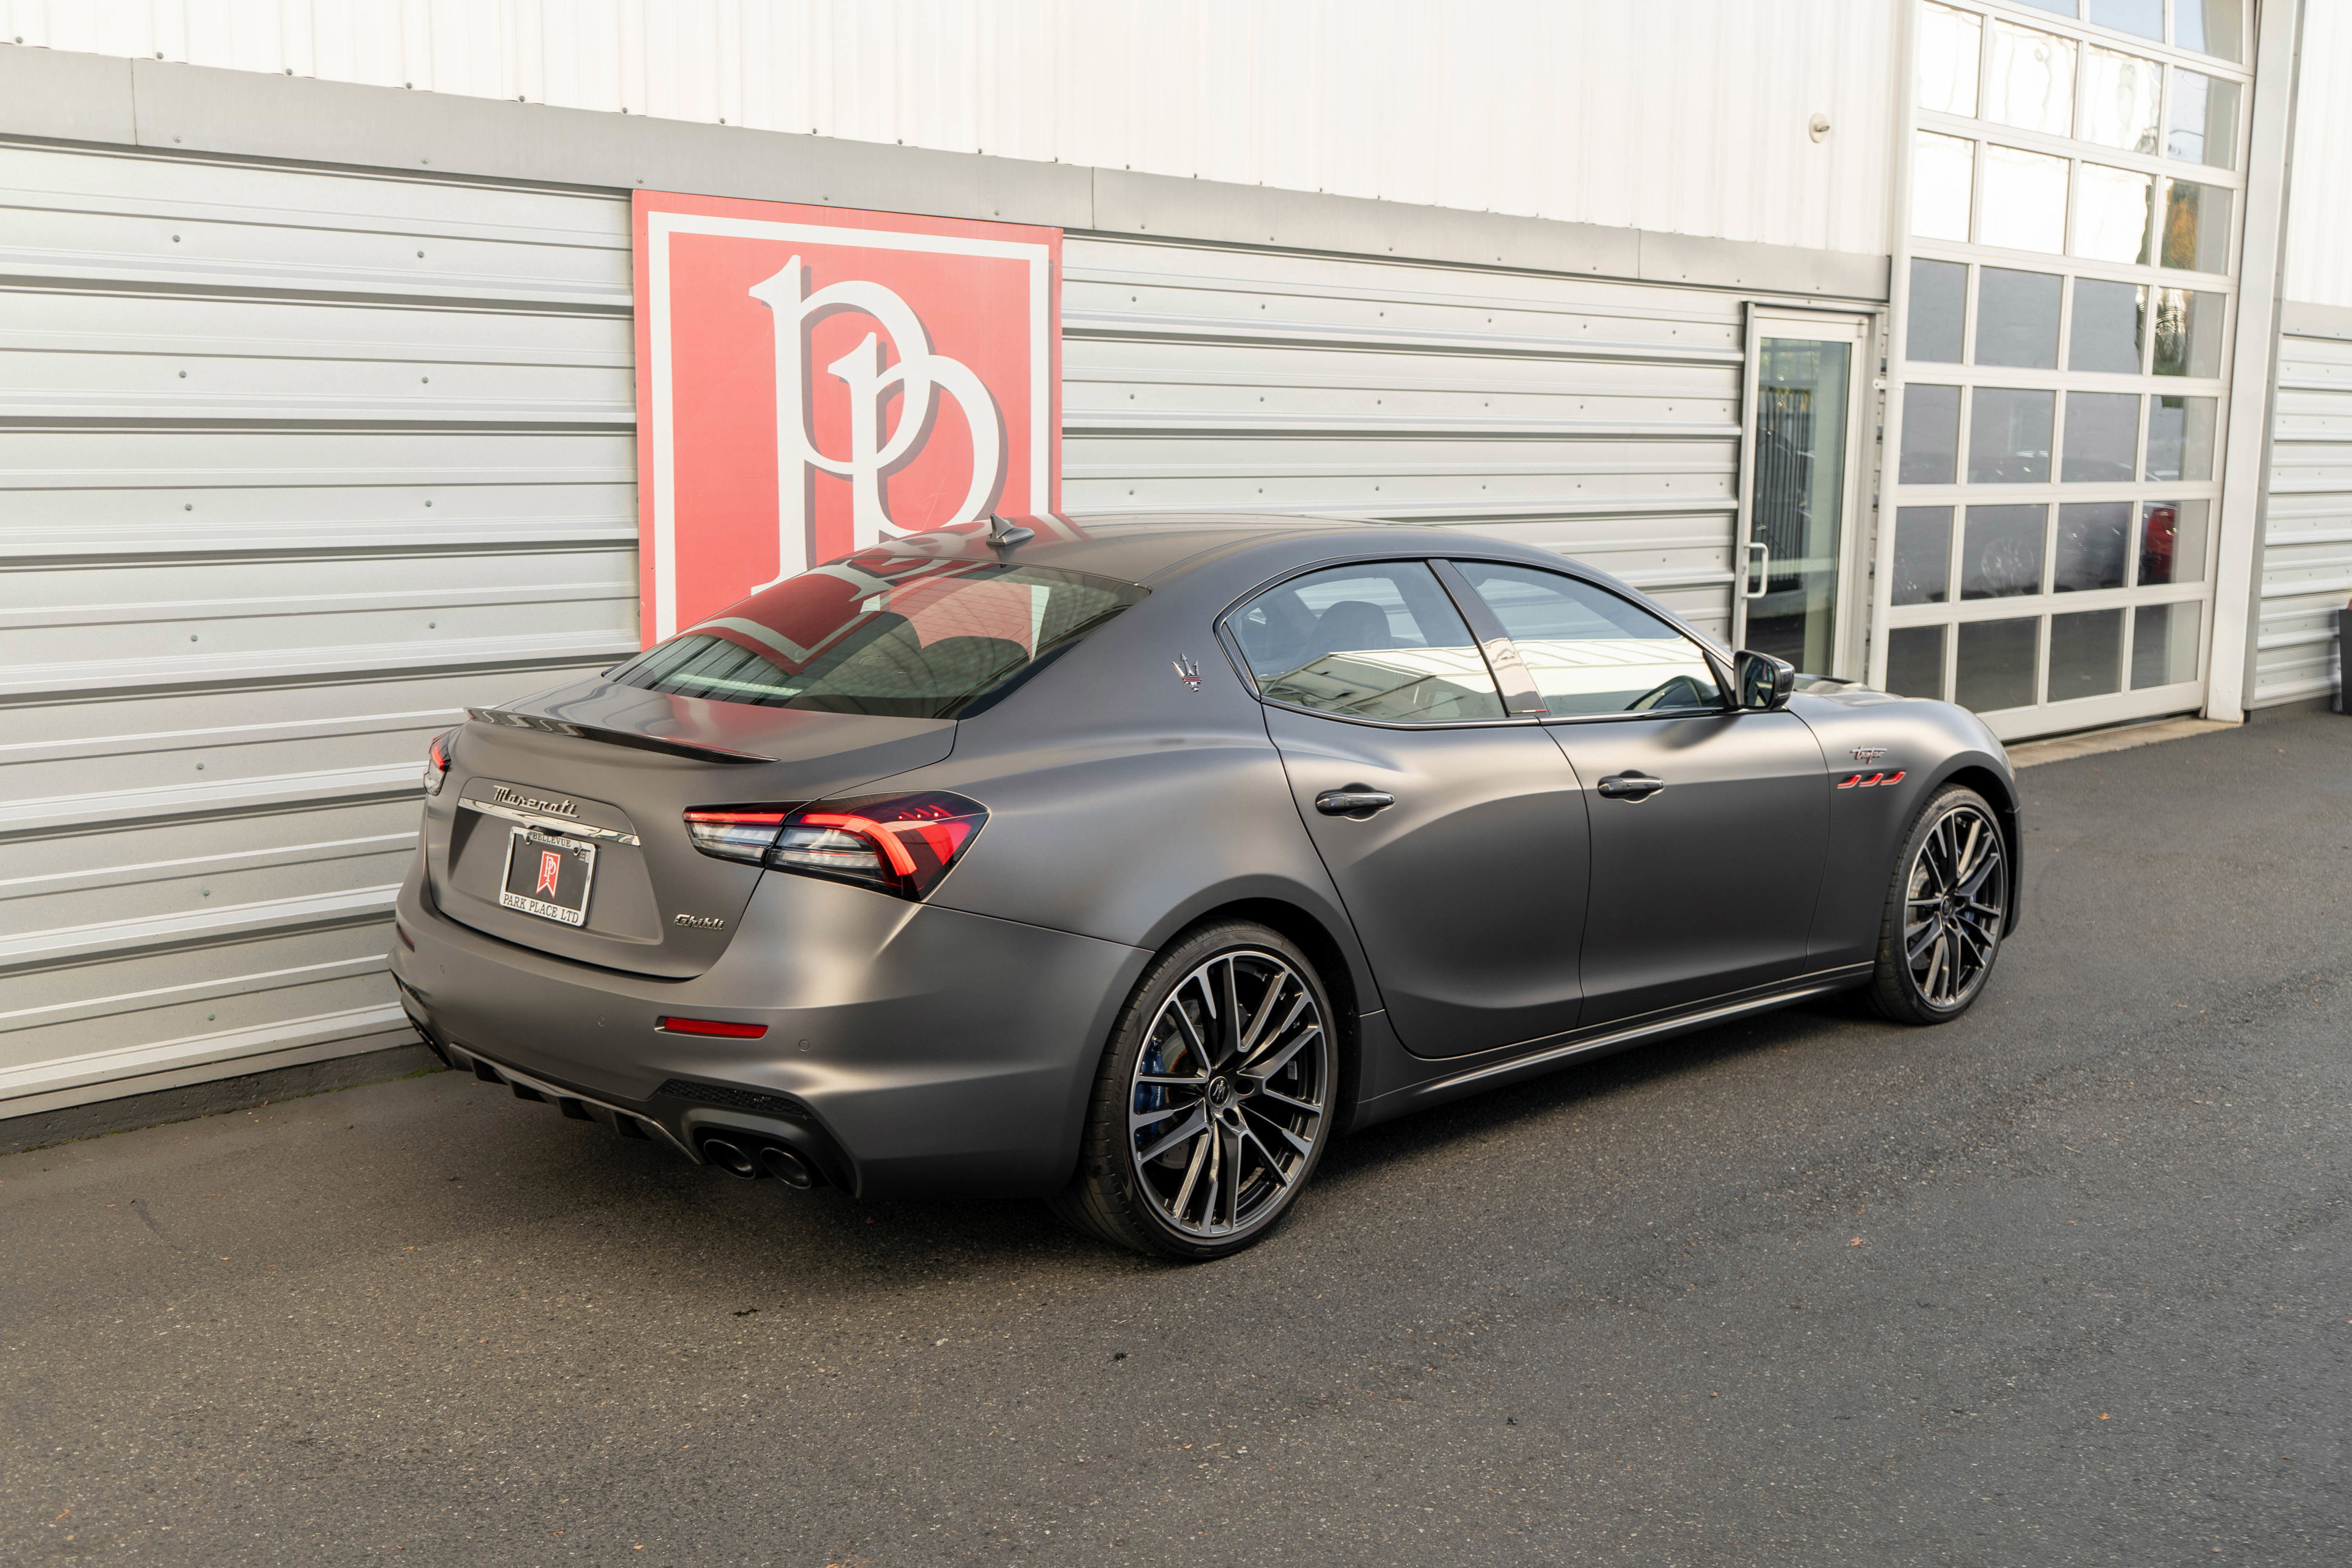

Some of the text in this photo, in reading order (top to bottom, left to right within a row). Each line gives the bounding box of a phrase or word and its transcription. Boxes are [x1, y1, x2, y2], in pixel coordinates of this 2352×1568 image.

[493, 785, 579, 818] Maserati
[533, 832, 571, 847] BELLEVUE
[503, 893, 579, 923] PARK PLACE LTD
[674, 914, 724, 931] Ghibli
